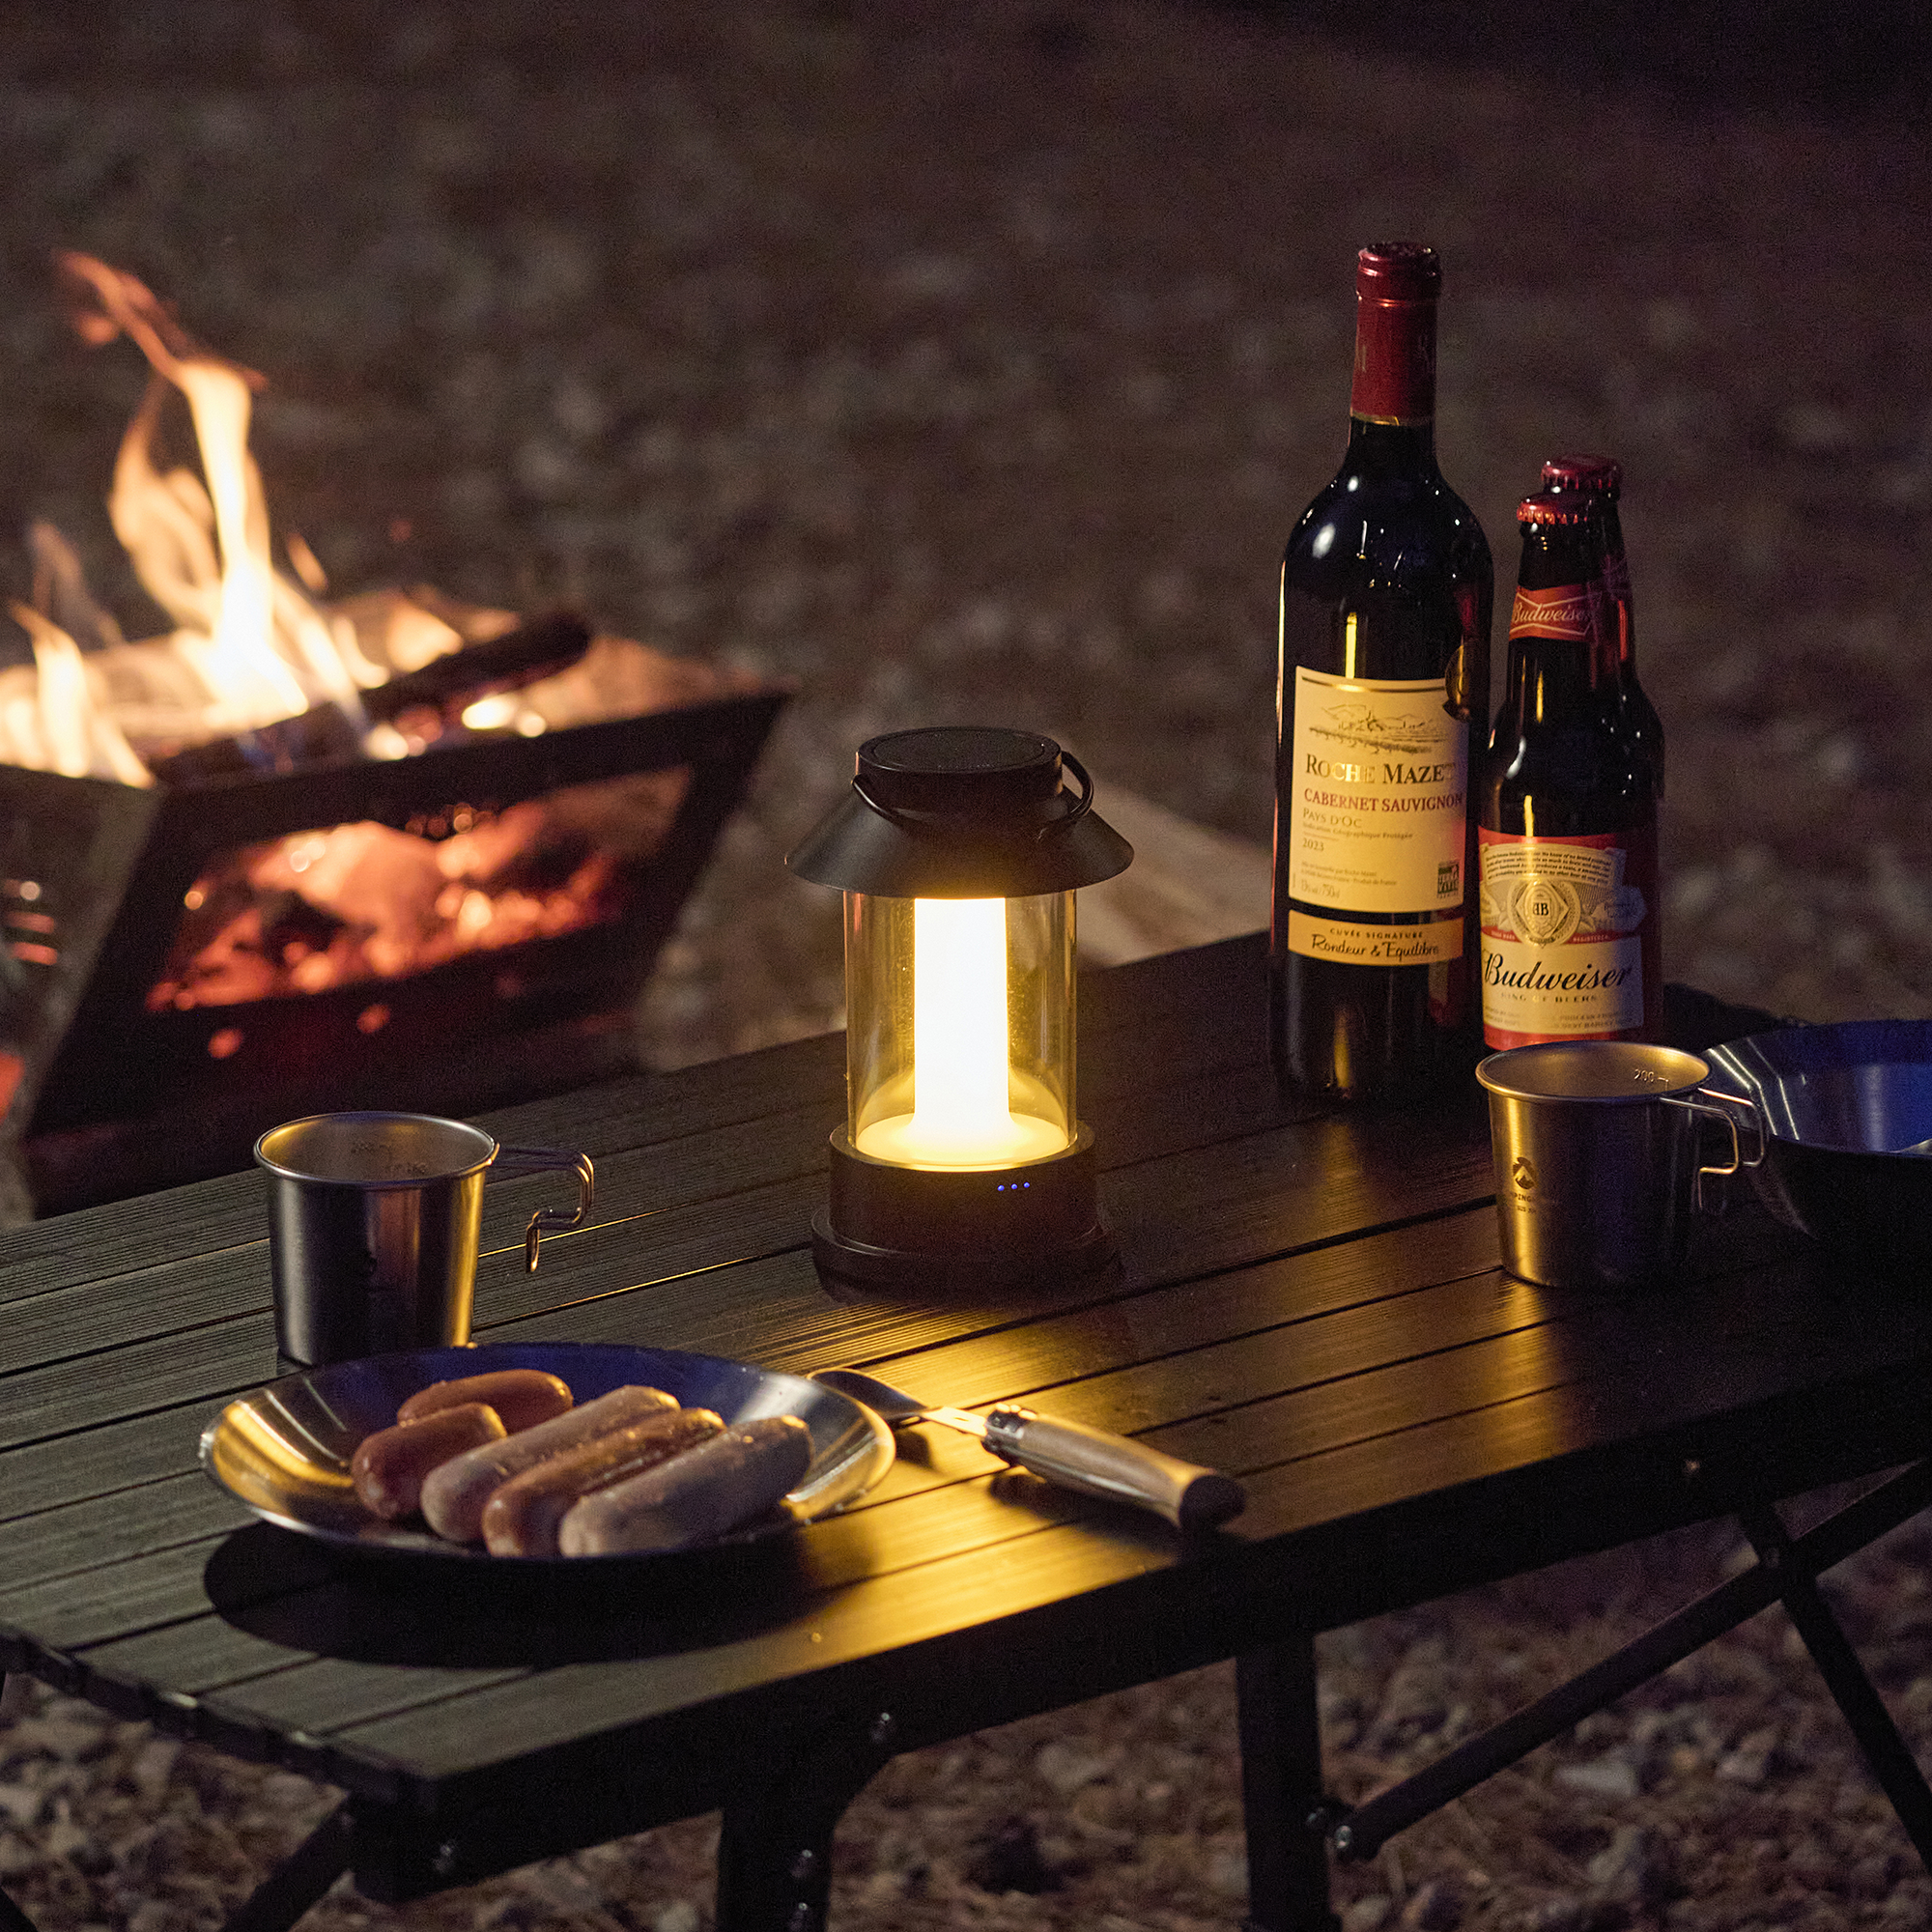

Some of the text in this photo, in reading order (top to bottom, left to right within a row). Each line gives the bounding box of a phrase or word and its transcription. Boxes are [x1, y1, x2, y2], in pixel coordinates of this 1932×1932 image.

[1306, 753, 1376, 783] ROCHE
[1304, 787, 1463, 812] CABERNET SAUVIGNON
[1302, 808, 1363, 829] PAYS D'OC
[1302, 838, 1324, 852] 2023
[1311, 934, 1367, 956] Rondeur
[1370, 945, 1381, 958] &
[1366, 930, 1423, 940] SIGNATURE
[1484, 952, 1633, 991] Budweiser
